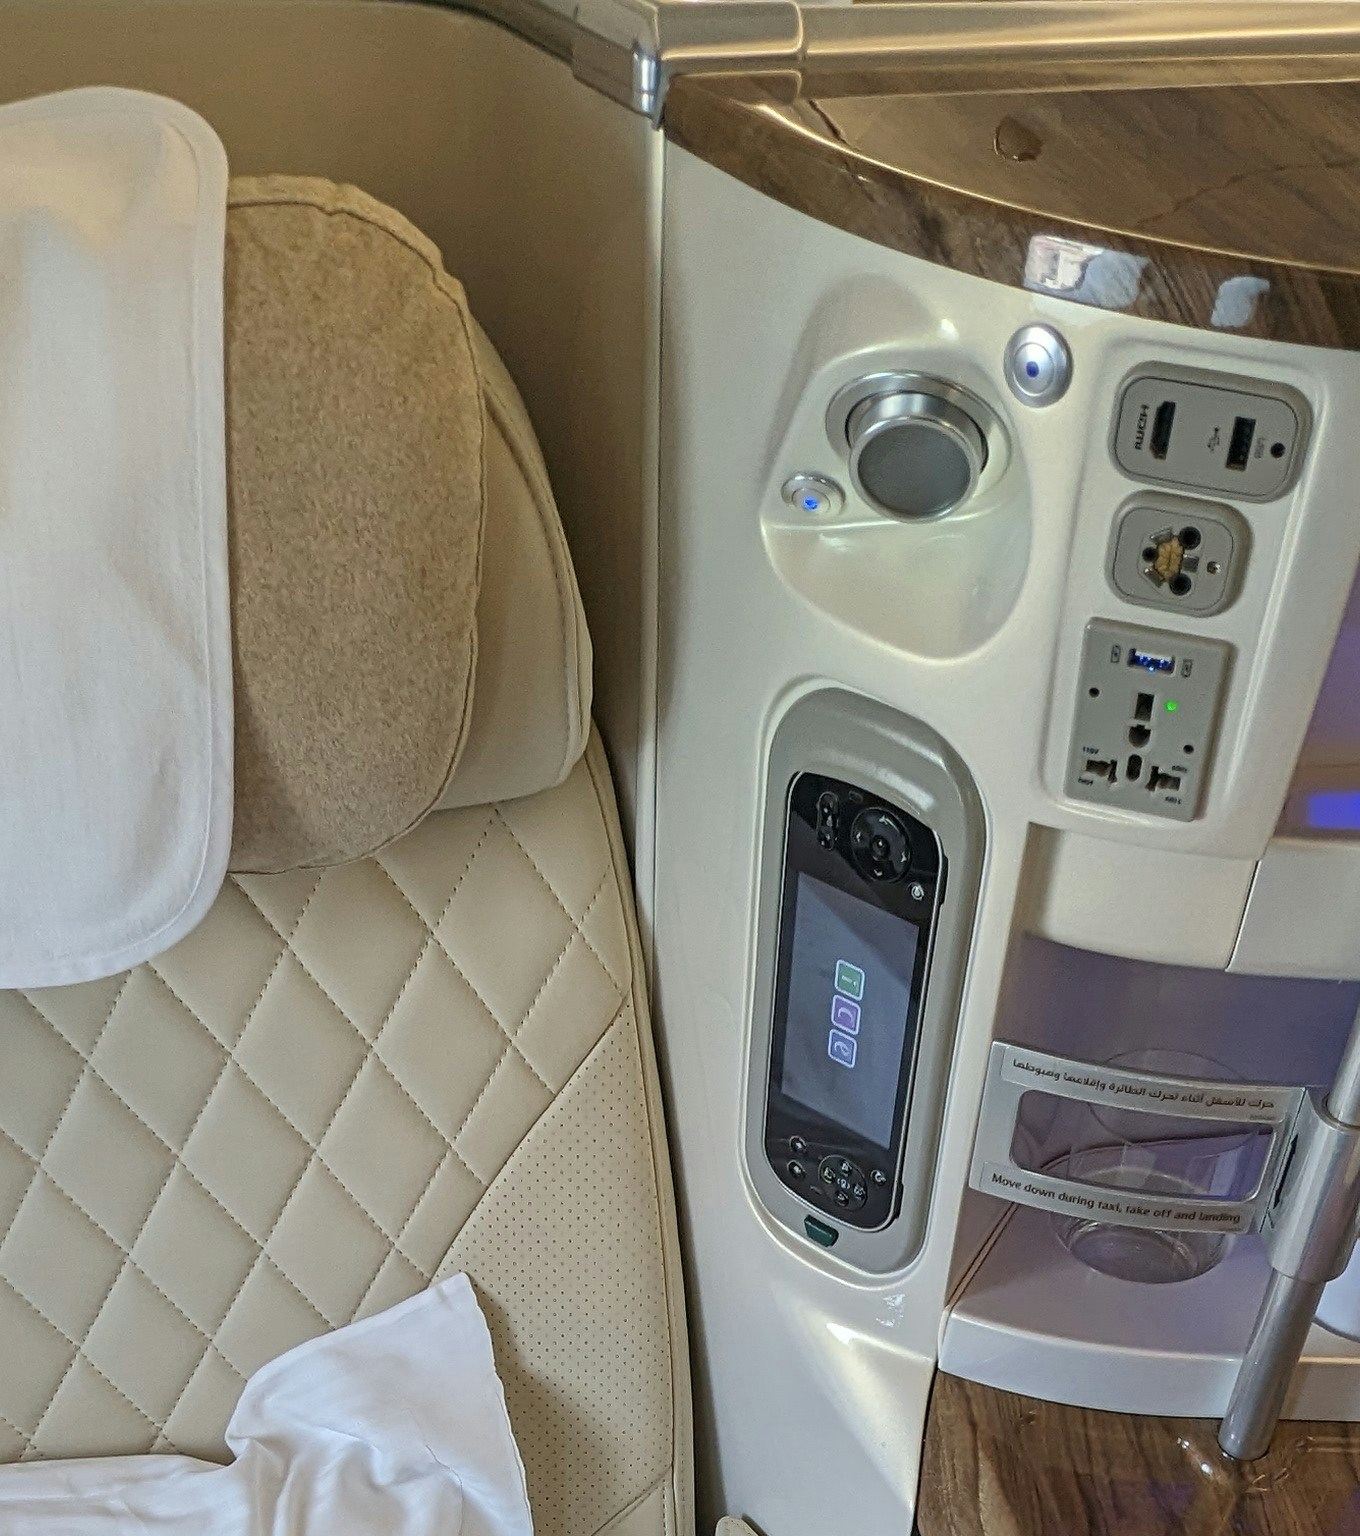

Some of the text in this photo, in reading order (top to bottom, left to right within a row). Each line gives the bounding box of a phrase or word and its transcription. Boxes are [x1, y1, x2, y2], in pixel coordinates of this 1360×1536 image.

[1109, 1081, 1146, 1096] الطائرة
[992, 1173, 1241, 1225] Move down during taxi, take off and landing
